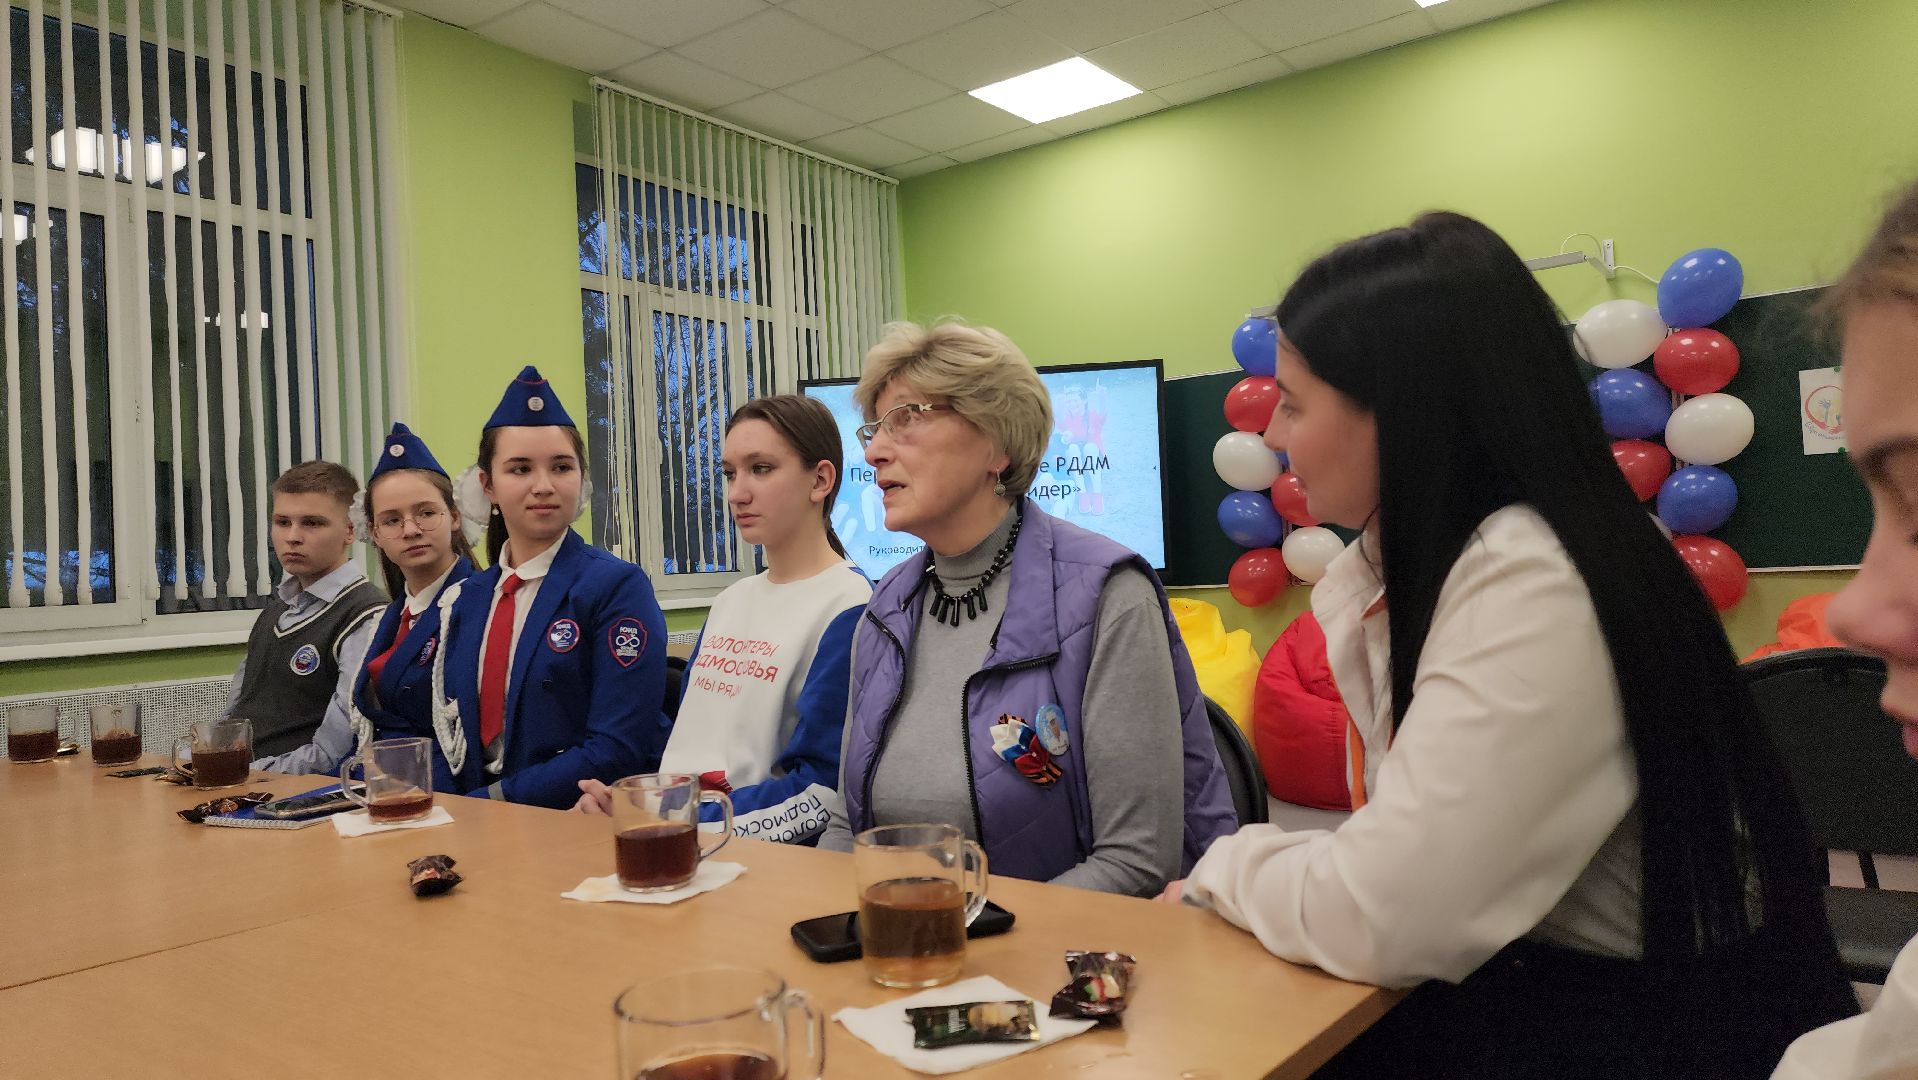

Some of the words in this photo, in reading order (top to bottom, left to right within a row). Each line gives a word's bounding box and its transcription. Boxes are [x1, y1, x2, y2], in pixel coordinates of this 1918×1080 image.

[1056, 455, 1110, 475] РДДМ
[1027, 484, 1081, 500] идер»
[869, 545, 925, 557] Руководит
